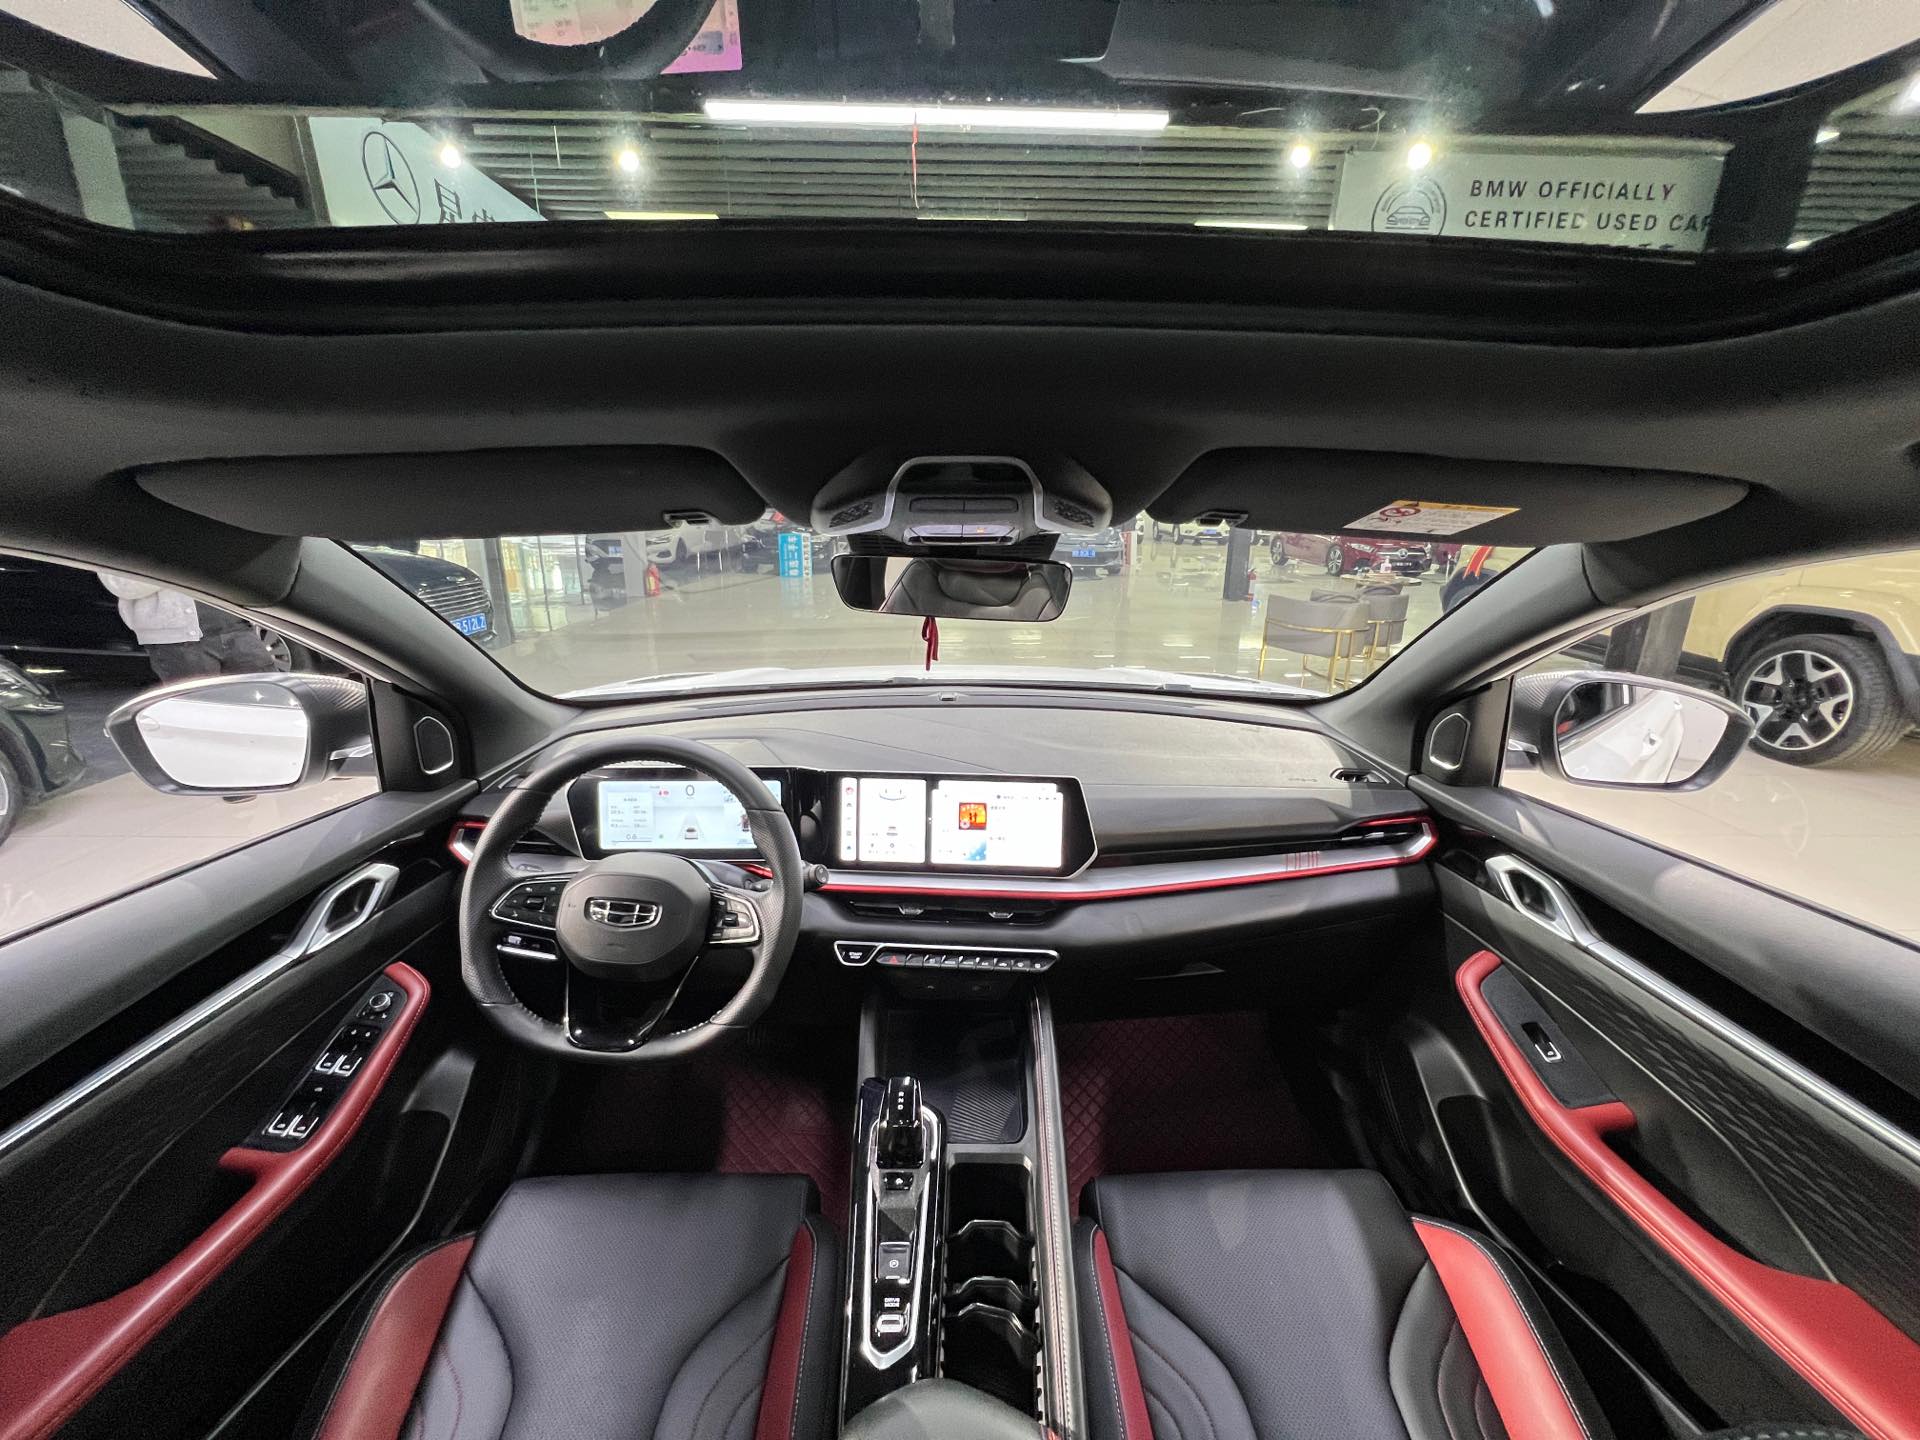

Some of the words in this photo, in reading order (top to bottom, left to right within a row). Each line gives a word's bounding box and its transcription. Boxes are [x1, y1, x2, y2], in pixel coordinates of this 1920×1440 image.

[1470, 180, 1527, 198] BMW
[1539, 181, 1676, 201] OFFICIALLY
[1465, 210, 1585, 229] CERTIFIED
[1597, 213, 1657, 231] USED
